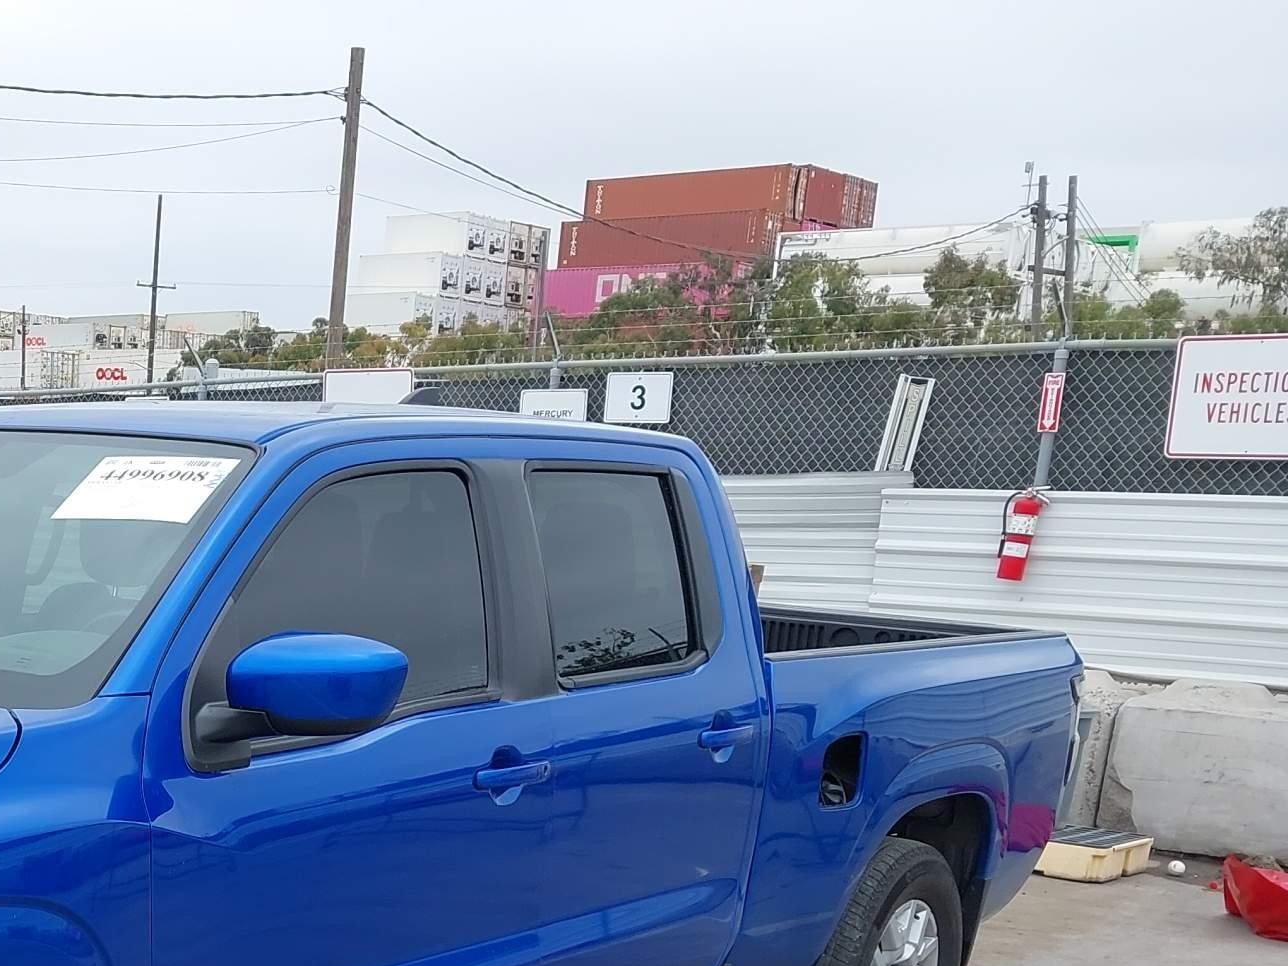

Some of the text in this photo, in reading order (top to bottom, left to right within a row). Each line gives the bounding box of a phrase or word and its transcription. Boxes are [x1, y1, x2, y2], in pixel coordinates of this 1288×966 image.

[26, 336, 46, 347] OOCL
[95, 367, 128, 381] OOCL
[630, 384, 647, 411] 3
[532, 409, 574, 419] MERCURY
[1206, 402, 1288, 424] VEHICLE
[100, 469, 210, 482] 44996908
